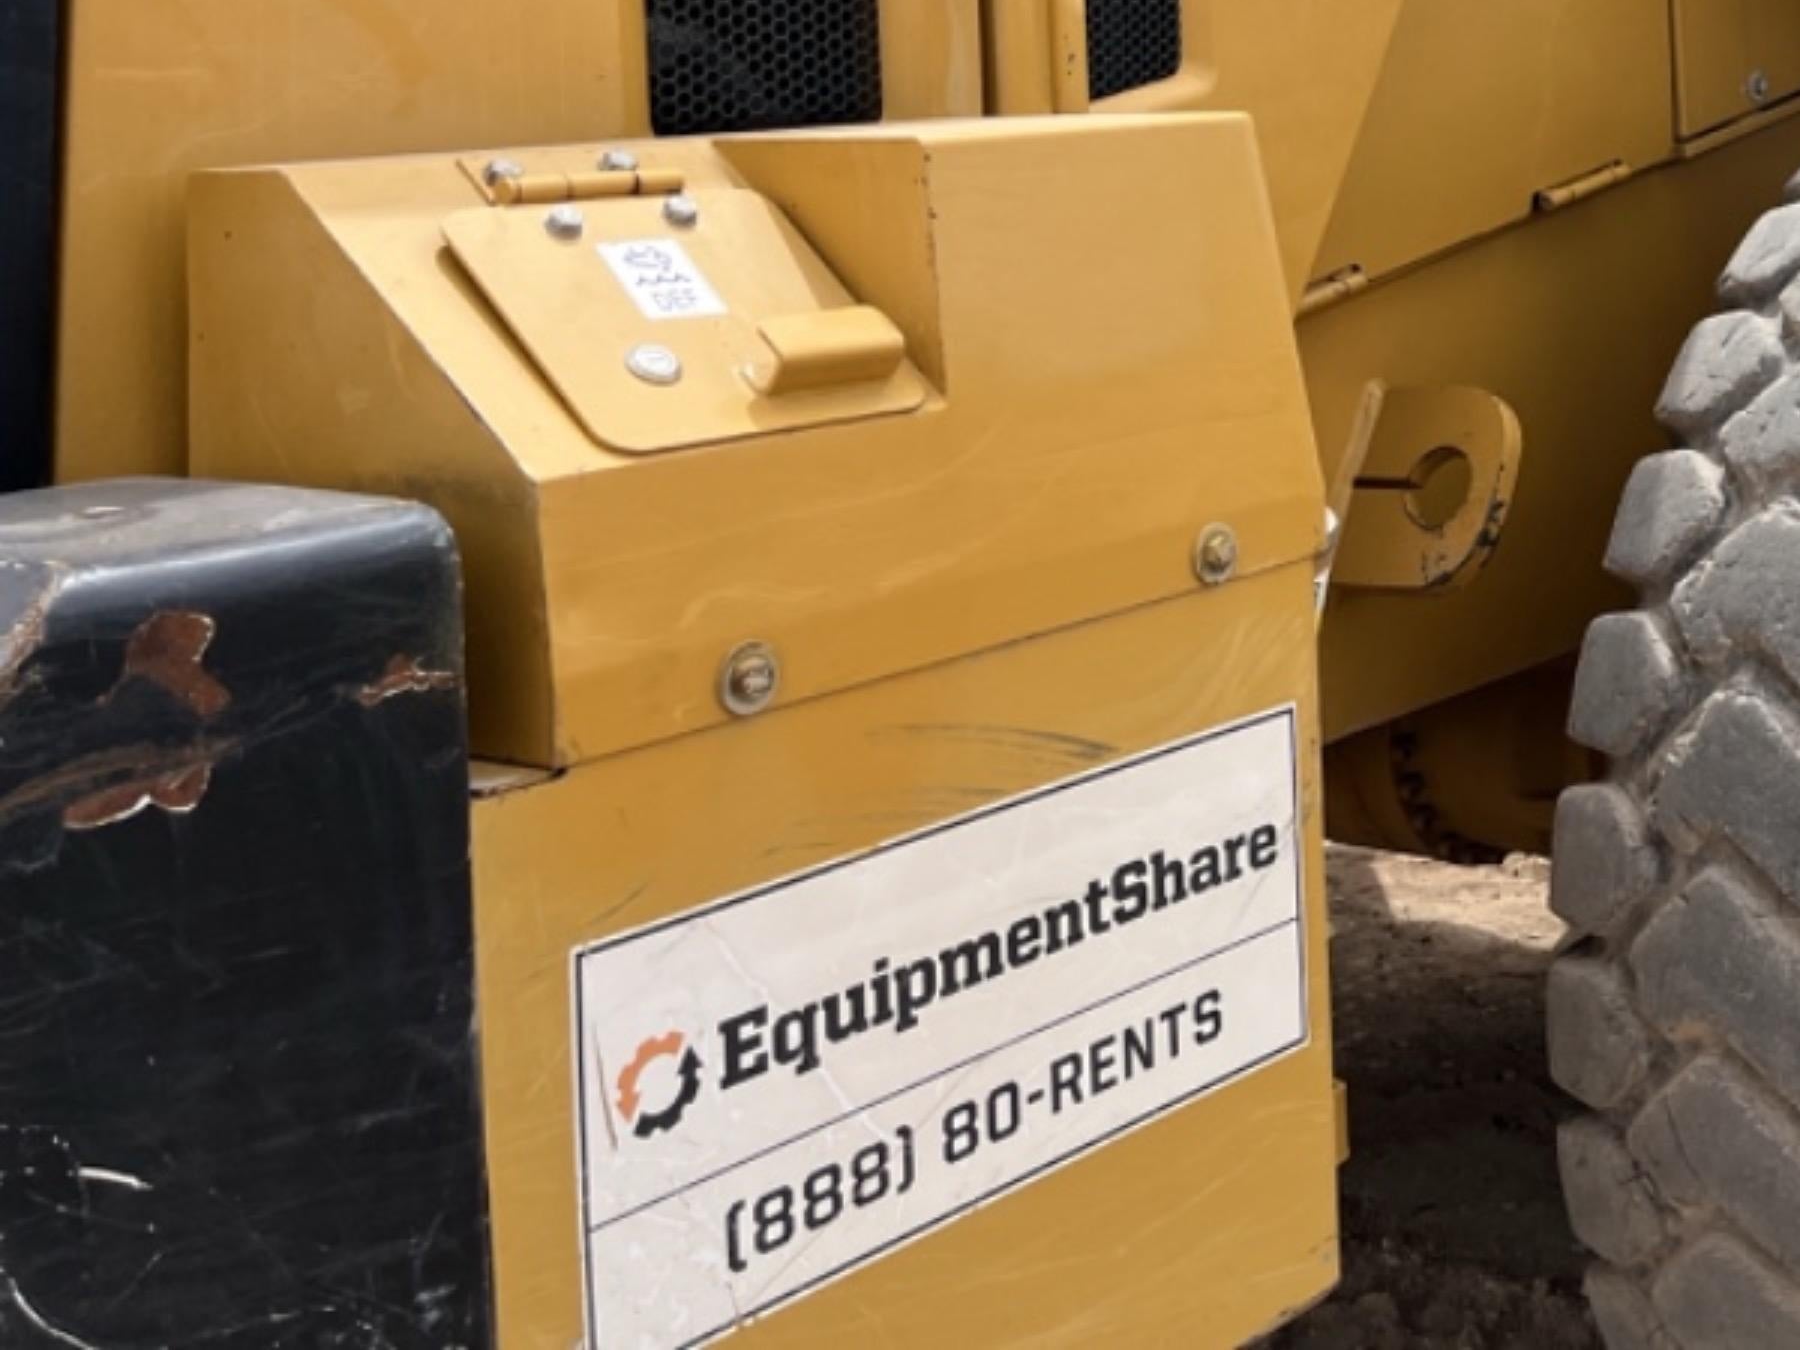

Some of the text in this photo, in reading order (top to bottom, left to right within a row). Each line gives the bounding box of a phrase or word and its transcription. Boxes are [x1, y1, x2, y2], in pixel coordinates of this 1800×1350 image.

[718, 821, 1279, 1090] EquipmentShare
[724, 989, 1224, 1274] (888) 80-RENTS
